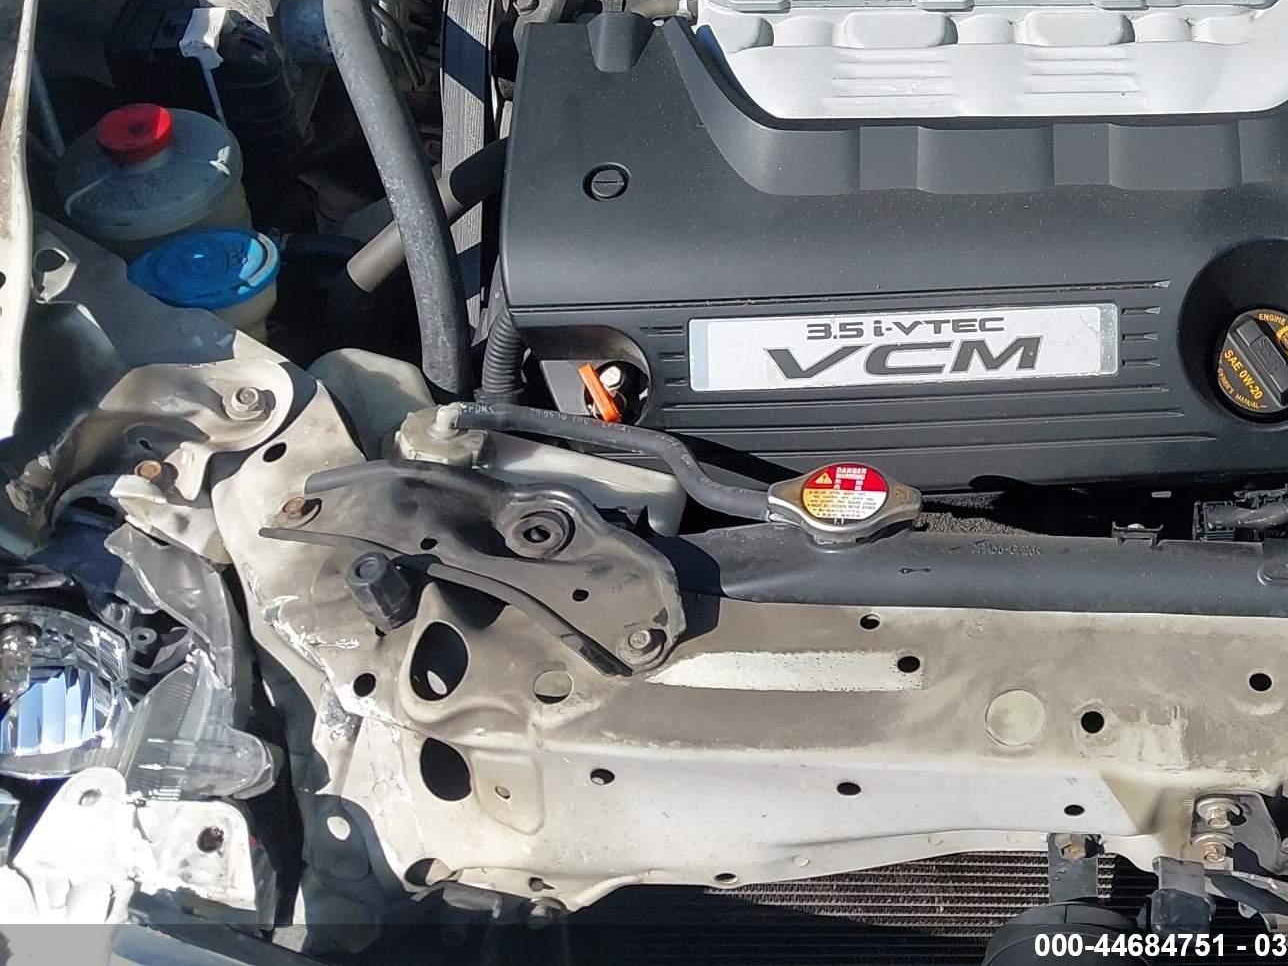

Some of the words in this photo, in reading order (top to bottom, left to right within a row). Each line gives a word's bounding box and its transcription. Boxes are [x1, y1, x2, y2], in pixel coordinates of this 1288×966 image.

[807, 322, 864, 341] 3.5
[872, 316, 1006, 339] i-VTEC
[1258, 313, 1287, 326] ENGINE
[765, 336, 1042, 379] VCM
[1224, 349, 1243, 371] SAE
[1238, 370, 1263, 400] 0W-20
[835, 466, 868, 475] DANGER
